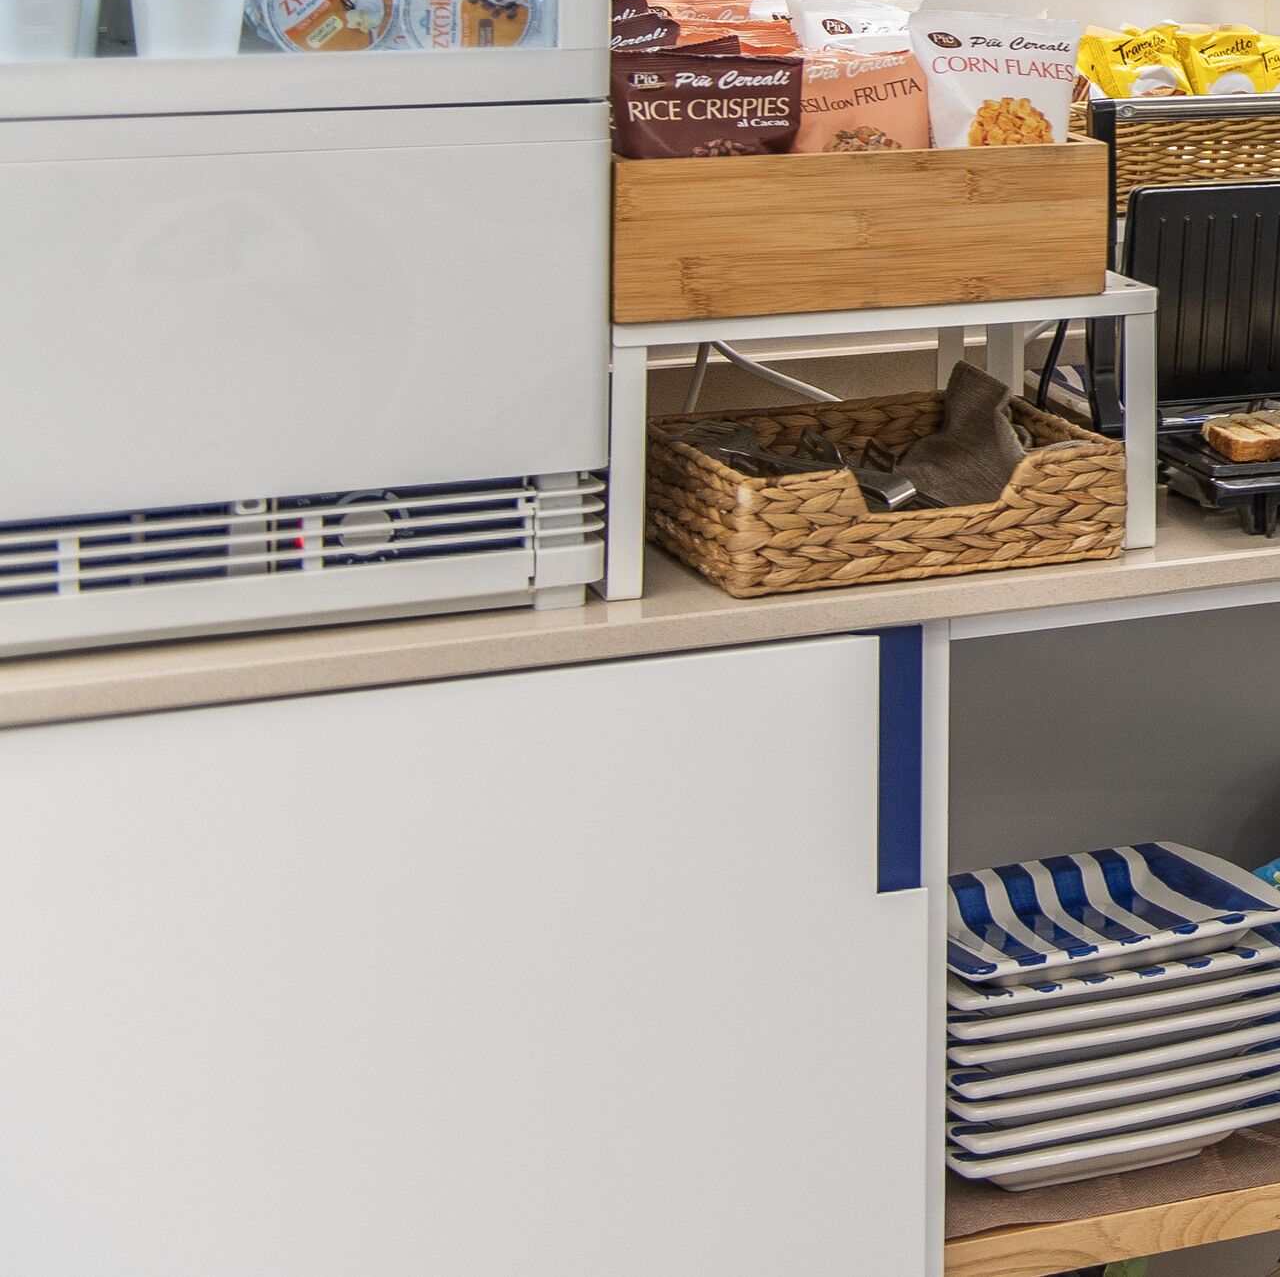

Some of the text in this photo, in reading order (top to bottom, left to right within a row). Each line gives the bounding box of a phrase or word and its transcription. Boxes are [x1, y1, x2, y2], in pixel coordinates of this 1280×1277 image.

[970, 36, 1003, 48] Più
[1010, 36, 1071, 53] Cereali
[674, 72, 714, 89] Più
[718, 70, 791, 90] Cereali
[932, 56, 1074, 83] CORN FLAKES
[854, 77, 923, 106] FRUTTA
[628, 97, 790, 122] RICE CRISPIES
[737, 119, 790, 128] al Cacao
